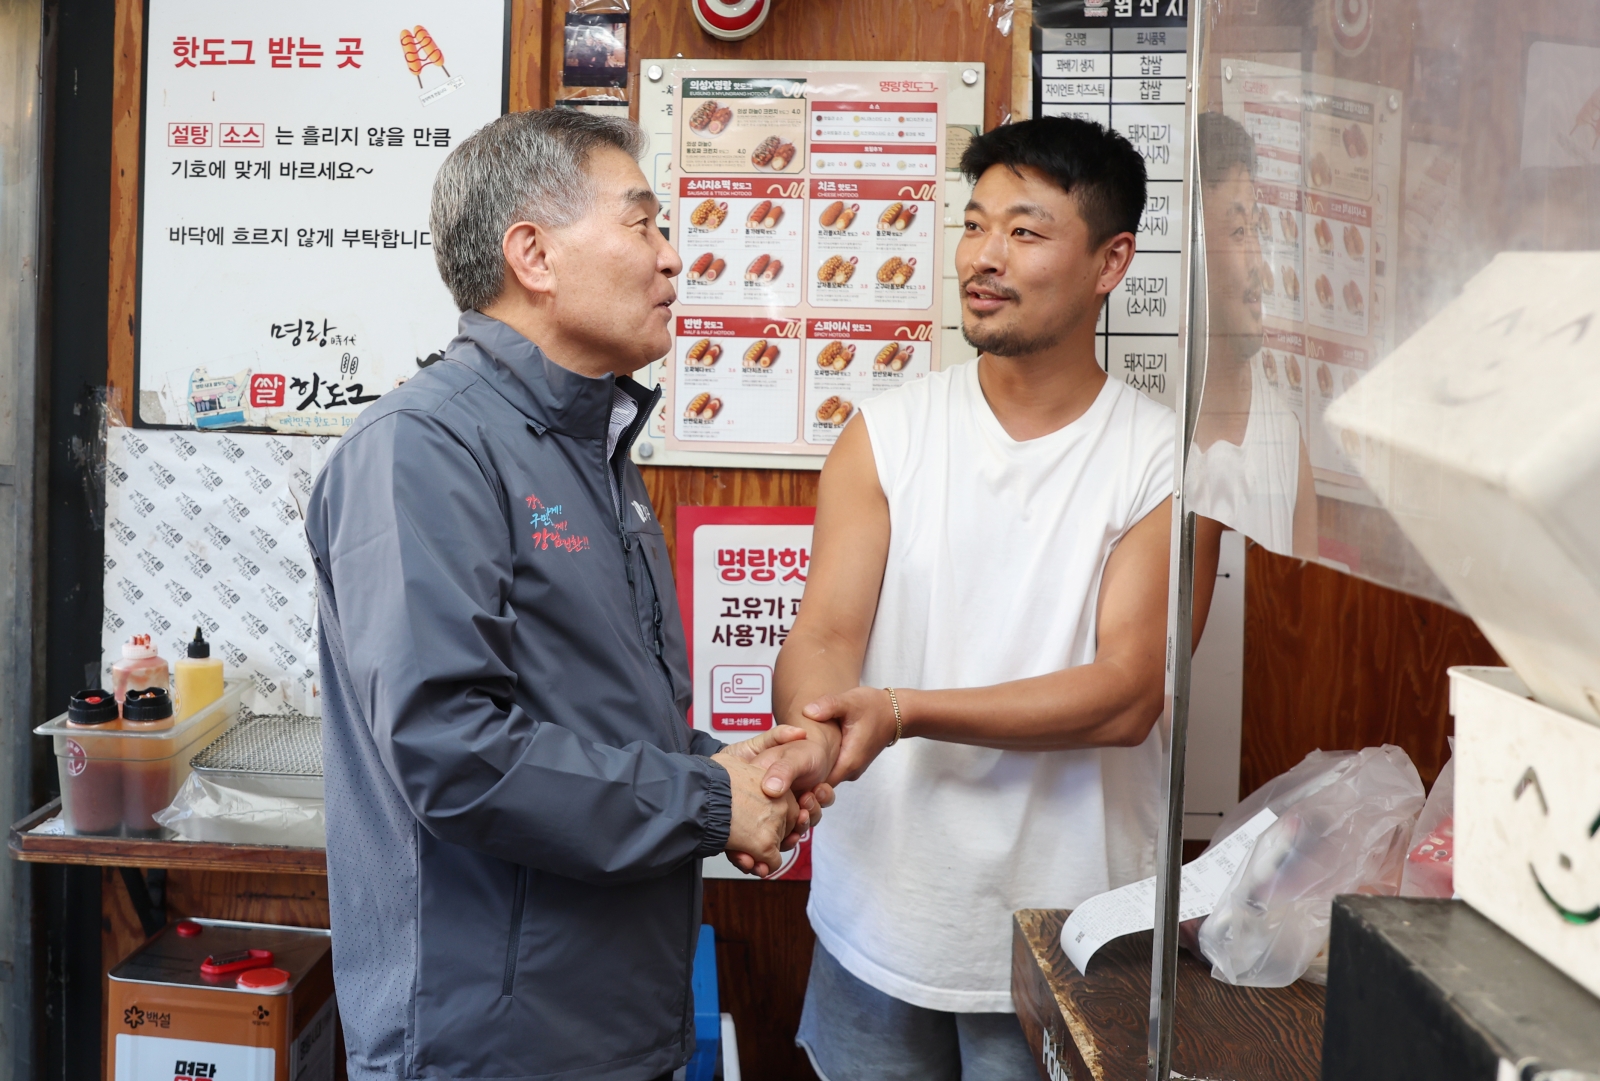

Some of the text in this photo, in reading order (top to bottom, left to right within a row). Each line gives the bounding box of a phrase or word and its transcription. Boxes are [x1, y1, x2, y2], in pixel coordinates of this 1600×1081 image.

[1065, 33, 1087, 46] 음식명
[1136, 32, 1166, 46] 표시품목
[173, 36, 364, 68] 핫도그 받는 곳
[1056, 59, 1094, 72] 꽈배기 생지
[1140, 56, 1162, 76] 찹쌀
[690, 80, 753, 90] 의성X명랑 핫도그
[880, 81, 938, 92] 명랑핫도그
[1046, 84, 1105, 97] 자이언트 치즈스틱
[1140, 80, 1162, 100] 찹쌀
[172, 126, 260, 145] 설탕 소스
[274, 126, 452, 146] 는 흘리지 않을 만큼
[1128, 124, 1171, 143] 돼지고기
[171, 160, 374, 180] 기호에 맞게 바르세요~
[687, 180, 752, 190] 소시지&떡 핫도그
[818, 182, 836, 191] 치즈
[1144, 195, 1170, 214] 고기
[170, 226, 224, 247] 바닥에
[232, 226, 289, 247] 흐르지
[296, 226, 334, 247] 않게
[1125, 277, 1168, 296] 돼지고기
[1127, 297, 1166, 317] (소시지)
[270, 318, 337, 348] 명랑
[684, 318, 724, 329] 반반 핫도그
[814, 322, 872, 332] 스파이시 핫도그
[330, 334, 356, 346] 時代
[1124, 353, 1166, 372] 돼지고기
[254, 372, 381, 410] 쌀 핫도그
[280, 416, 312, 427] 대한민국
[314, 416, 338, 427] 핫도그
[720, 597, 785, 619] 고유가
[146, 1011, 170, 1028] 백설
